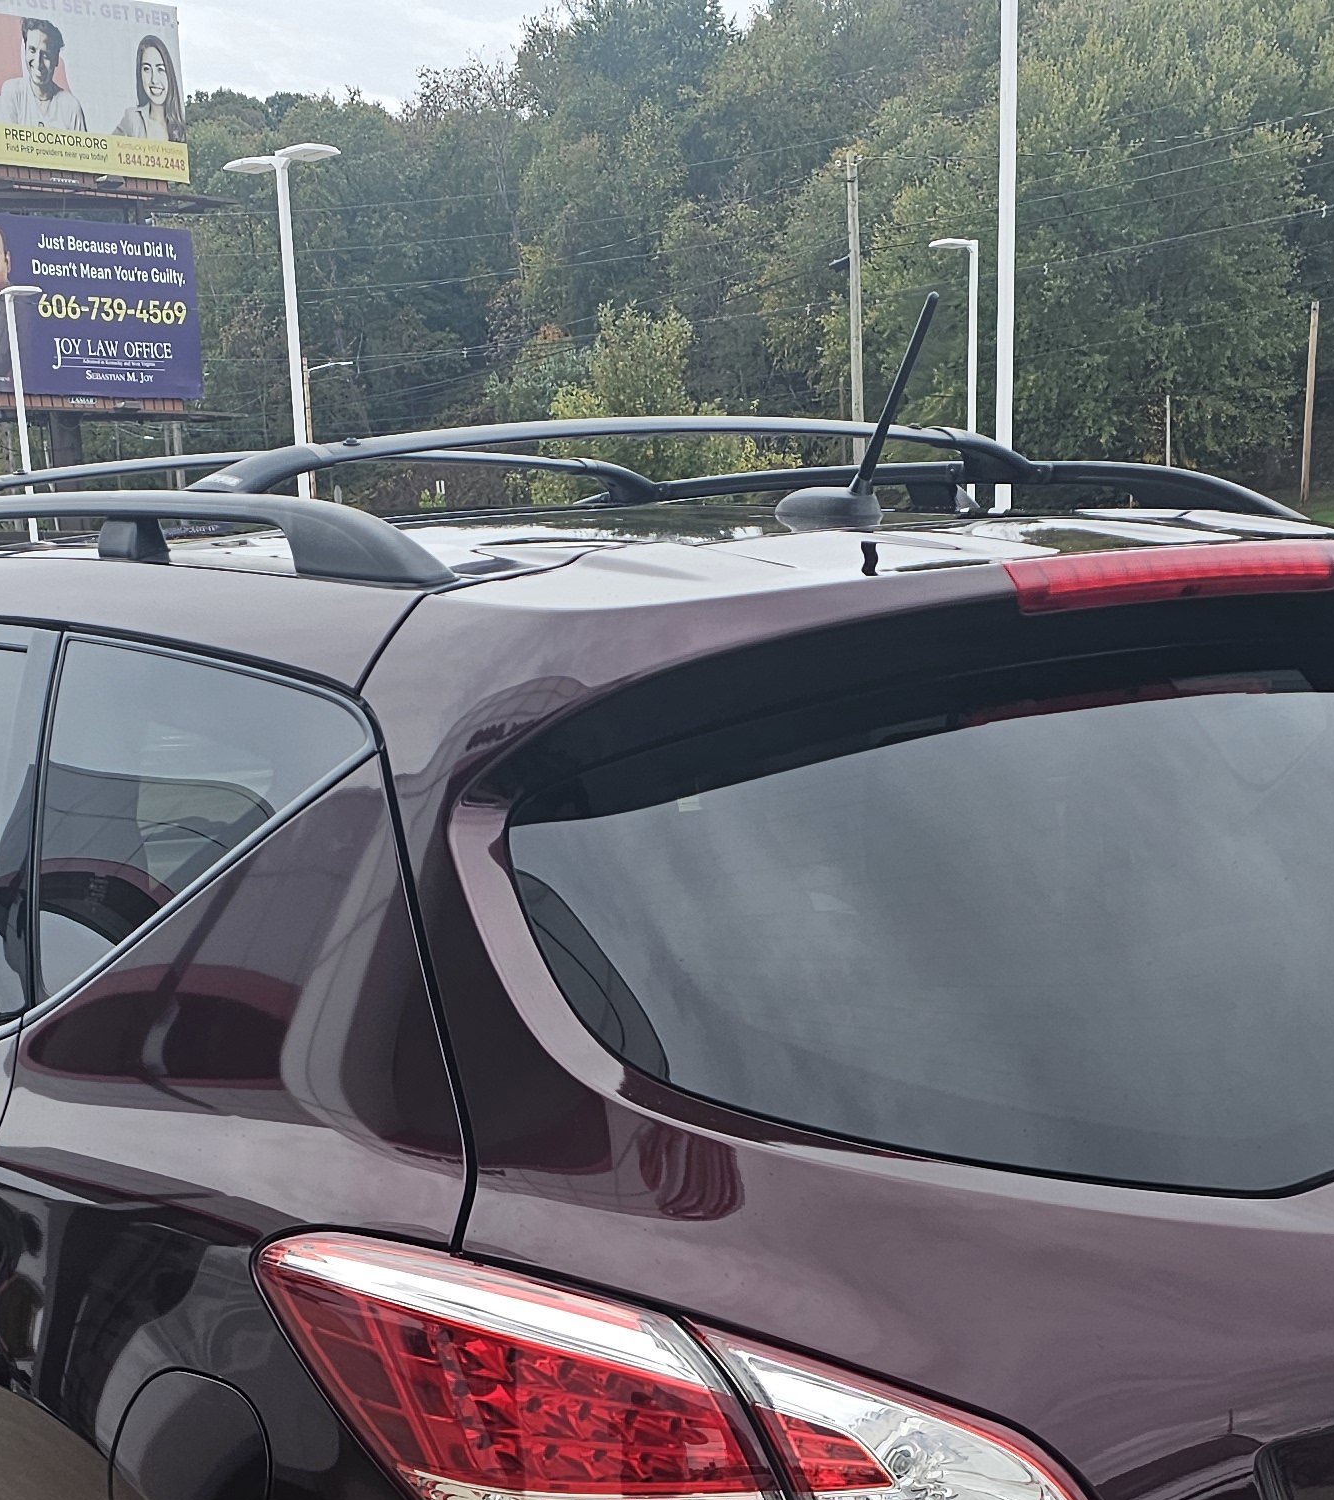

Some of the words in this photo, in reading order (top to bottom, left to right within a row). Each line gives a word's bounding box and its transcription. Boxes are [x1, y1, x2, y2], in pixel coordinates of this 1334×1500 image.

[67, 1, 96, 17] SET.
[100, 7, 130, 21] GET
[135, 8, 175, 28] PrEP.
[4, 128, 108, 150] PREPLOCATOR.ORG
[118, 152, 186, 171] 1.844.294.2448
[37, 233, 65, 251] Just
[67, 235, 118, 254] Because
[120, 239, 142, 256] You
[143, 241, 163, 258] Did
[165, 242, 177, 260] It,
[31, 258, 78, 278] Doesn't
[79, 262, 112, 280] Mean
[113, 265, 148, 282] You're
[151, 267, 186, 288] Guilty.
[38, 292, 187, 325] 606-739-4569
[52, 337, 81, 370] JOY
[87, 339, 118, 357] LAW
[124, 341, 173, 359] OFFICE
[86, 370, 126, 382] SEBASTIAN
[127, 372, 138, 382] M.
[140, 372, 154, 383] JOY
